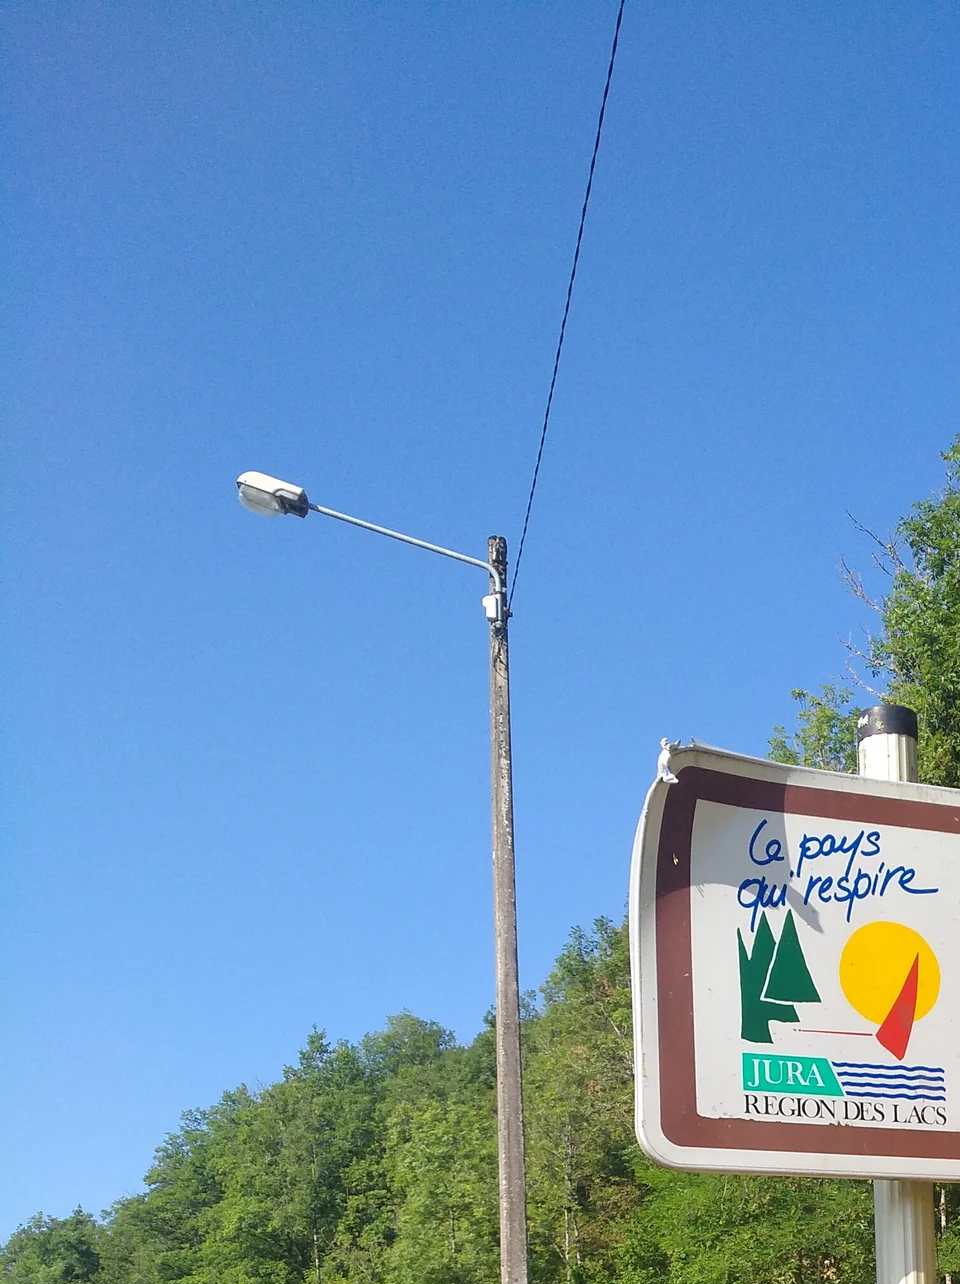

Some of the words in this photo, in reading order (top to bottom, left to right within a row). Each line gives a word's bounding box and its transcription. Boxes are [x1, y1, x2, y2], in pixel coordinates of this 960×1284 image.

[749, 819, 785, 866] Le
[796, 830, 881, 879] pays
[737, 870, 795, 933] qui
[803, 862, 939, 923] respire
[747, 1058, 826, 1088] JURA
[743, 1094, 836, 1120] REGION
[843, 1100, 885, 1122] DES
[892, 1104, 947, 1126] LACS
